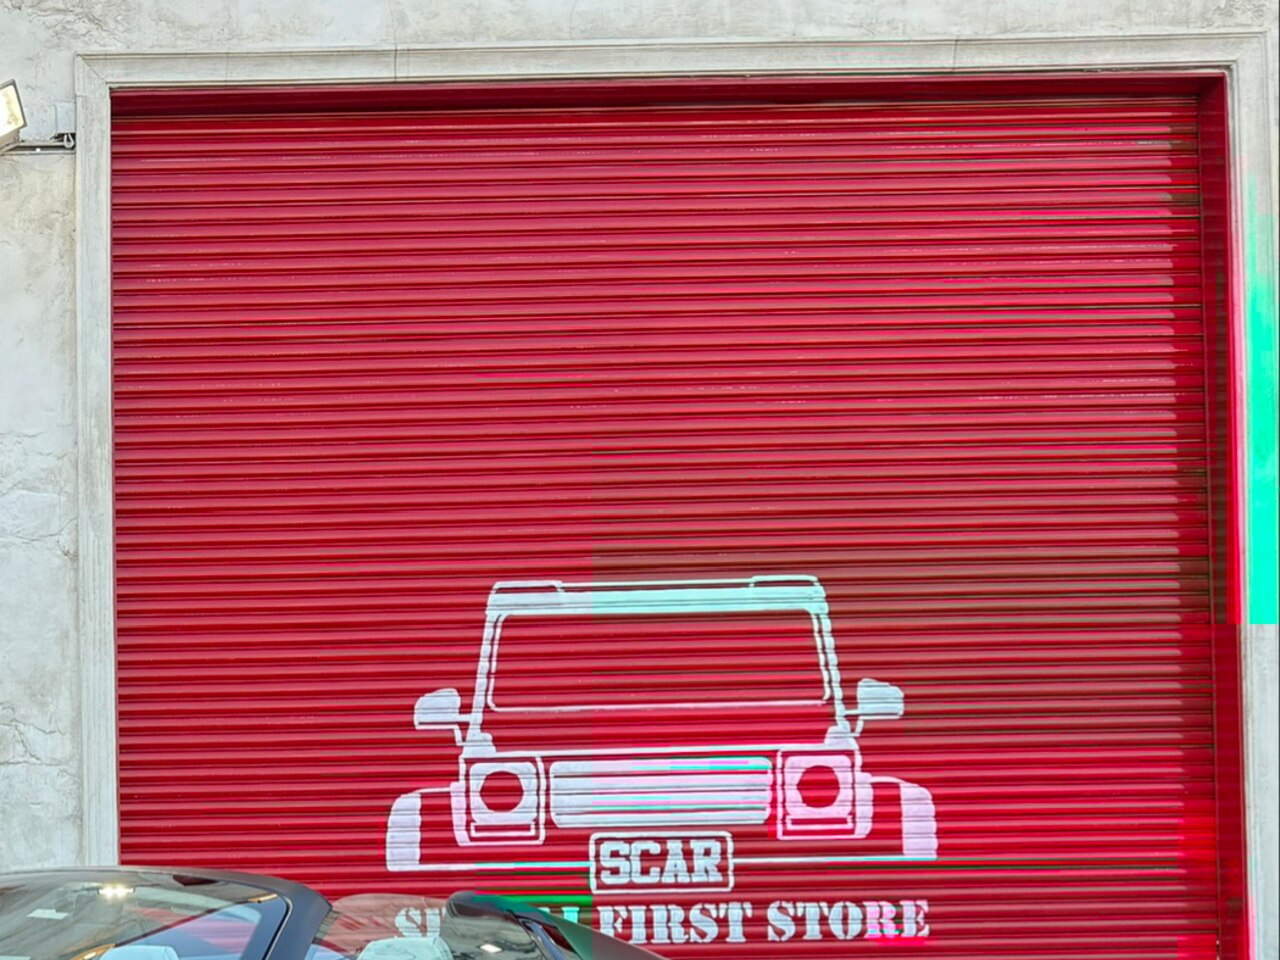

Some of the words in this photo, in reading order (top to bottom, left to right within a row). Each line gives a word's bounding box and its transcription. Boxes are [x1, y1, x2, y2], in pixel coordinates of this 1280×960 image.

[600, 839, 724, 885] SCAR
[596, 901, 752, 944] FIRST
[767, 899, 930, 942] STORE
